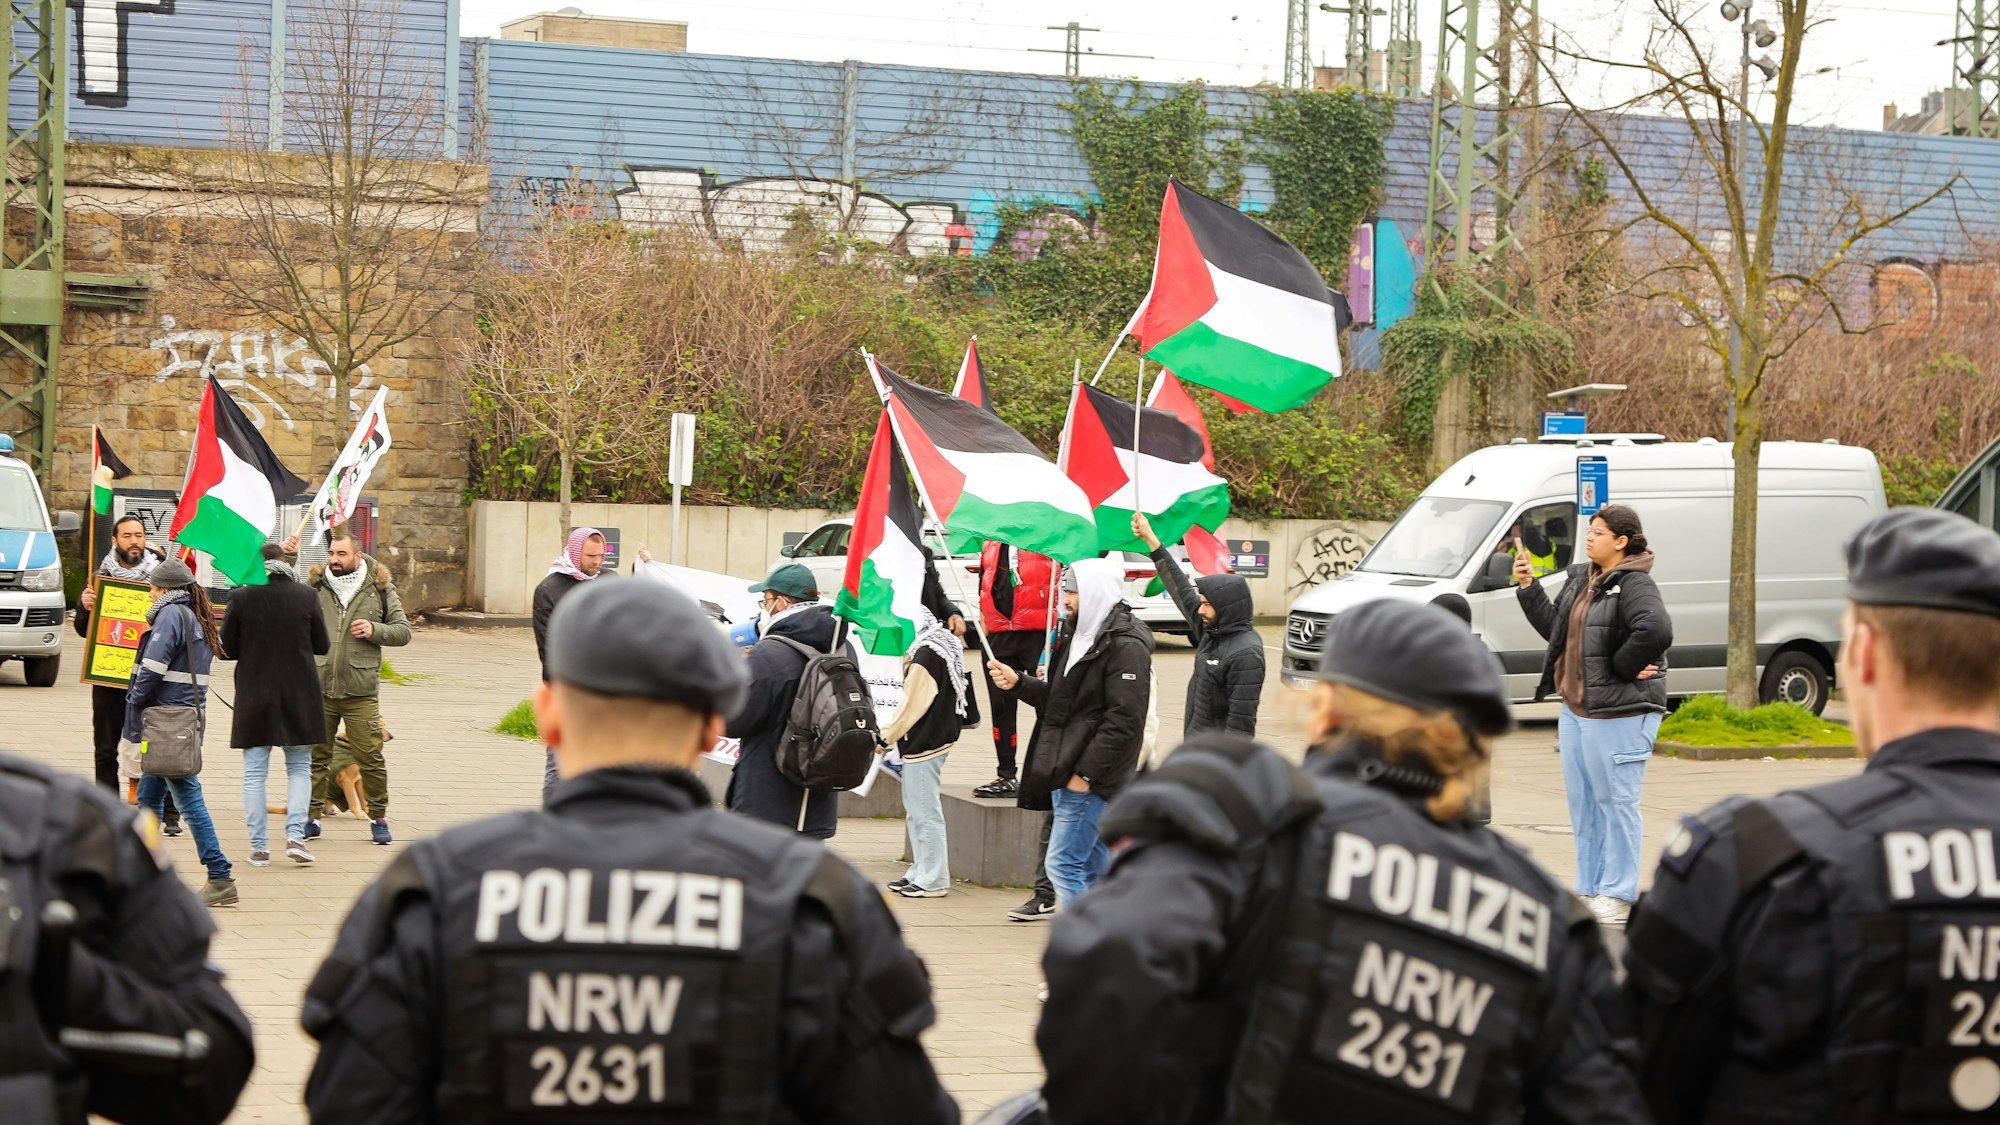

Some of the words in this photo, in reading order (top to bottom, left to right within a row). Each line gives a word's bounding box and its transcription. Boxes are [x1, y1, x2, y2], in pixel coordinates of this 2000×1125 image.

[475, 867, 744, 950] POLIZEI
[1327, 831, 1551, 972] POLIZEI
[527, 971, 684, 1035] NRW
[1352, 941, 1494, 1036] NRW
[530, 1043, 666, 1106] 2631
[1337, 1007, 1466, 1098] 2631
